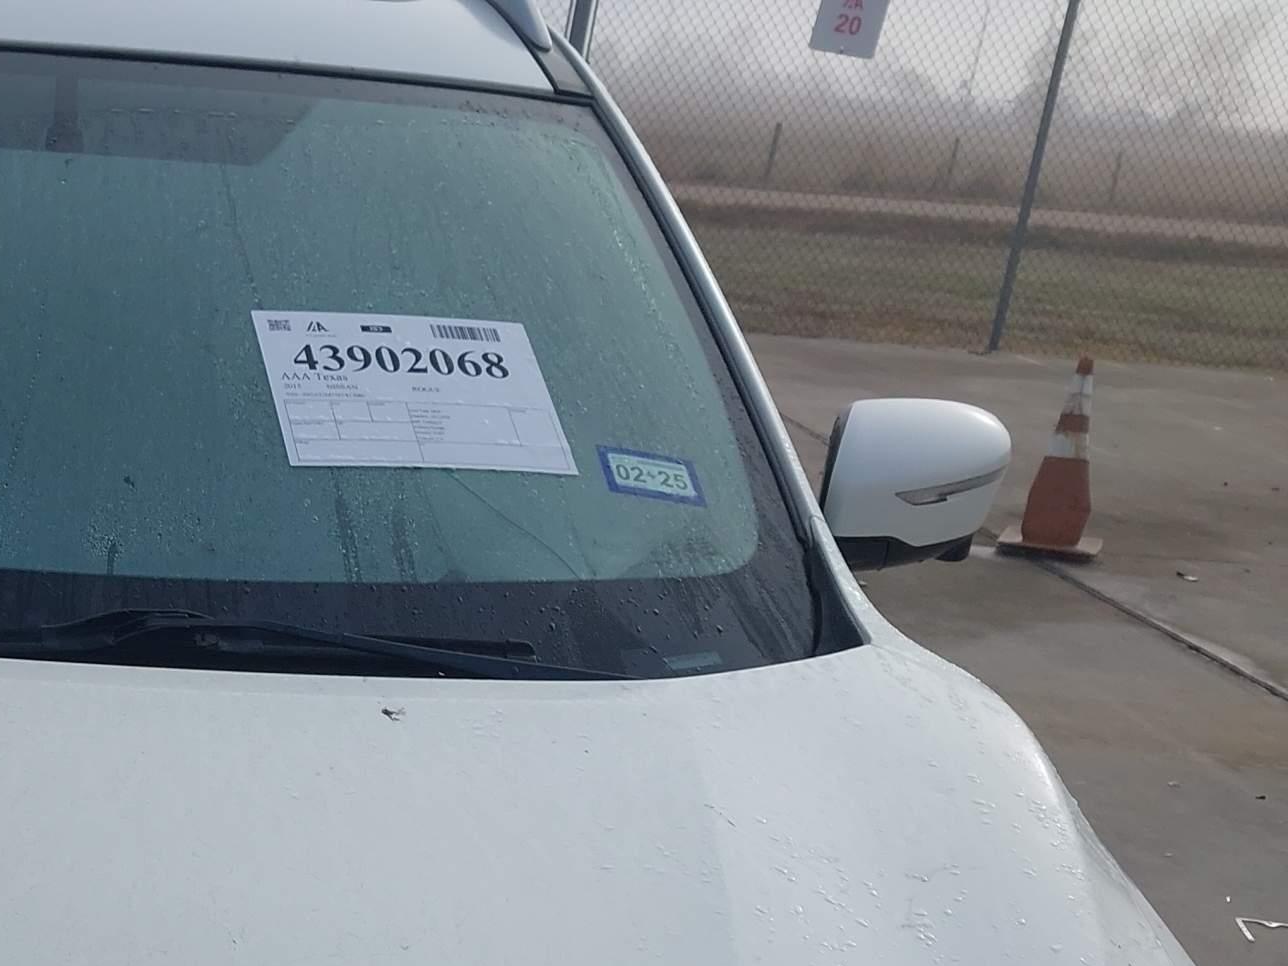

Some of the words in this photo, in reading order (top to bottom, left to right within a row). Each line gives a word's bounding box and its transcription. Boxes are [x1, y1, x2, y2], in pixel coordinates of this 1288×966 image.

[833, 13, 863, 36] 20
[294, 343, 510, 379] 43902068
[281, 372, 311, 381] AAA
[313, 372, 349, 382] Texas
